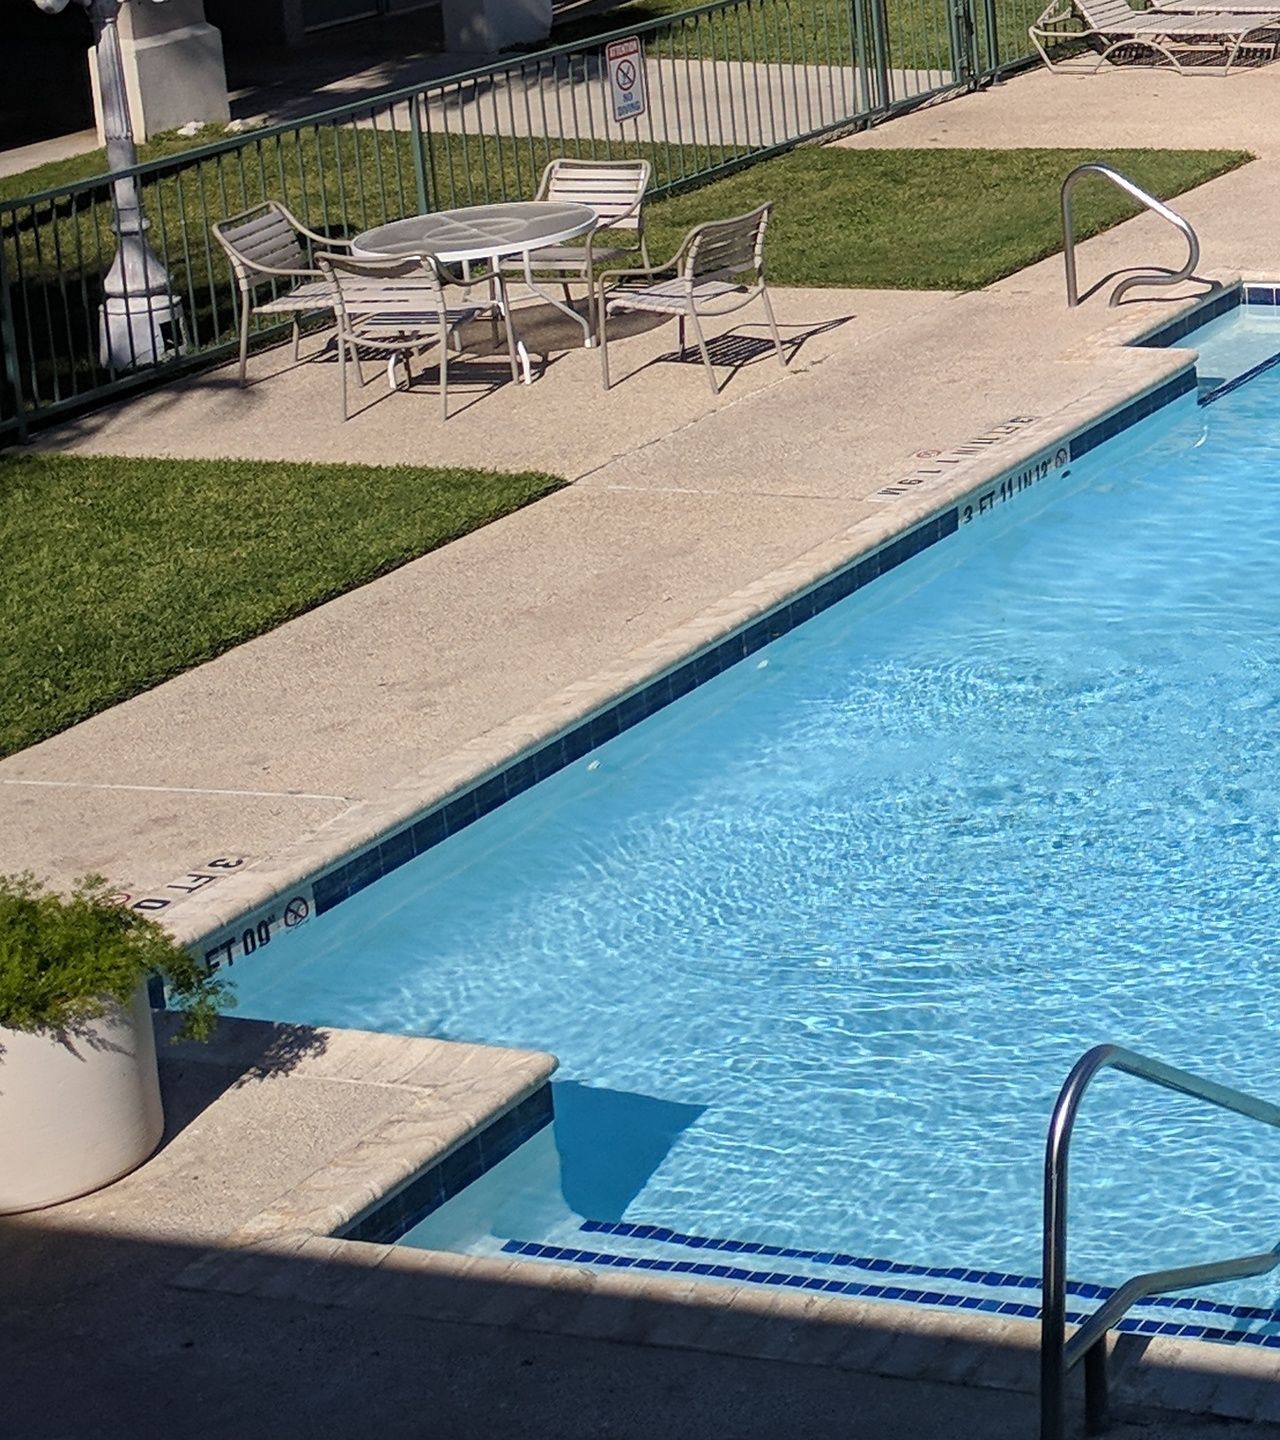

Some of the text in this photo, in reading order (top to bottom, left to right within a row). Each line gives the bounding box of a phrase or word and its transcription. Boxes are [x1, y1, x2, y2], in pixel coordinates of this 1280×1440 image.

[622, 92, 633, 102] NO
[979, 490, 996, 516] FT
[167, 874, 217, 894] FT
